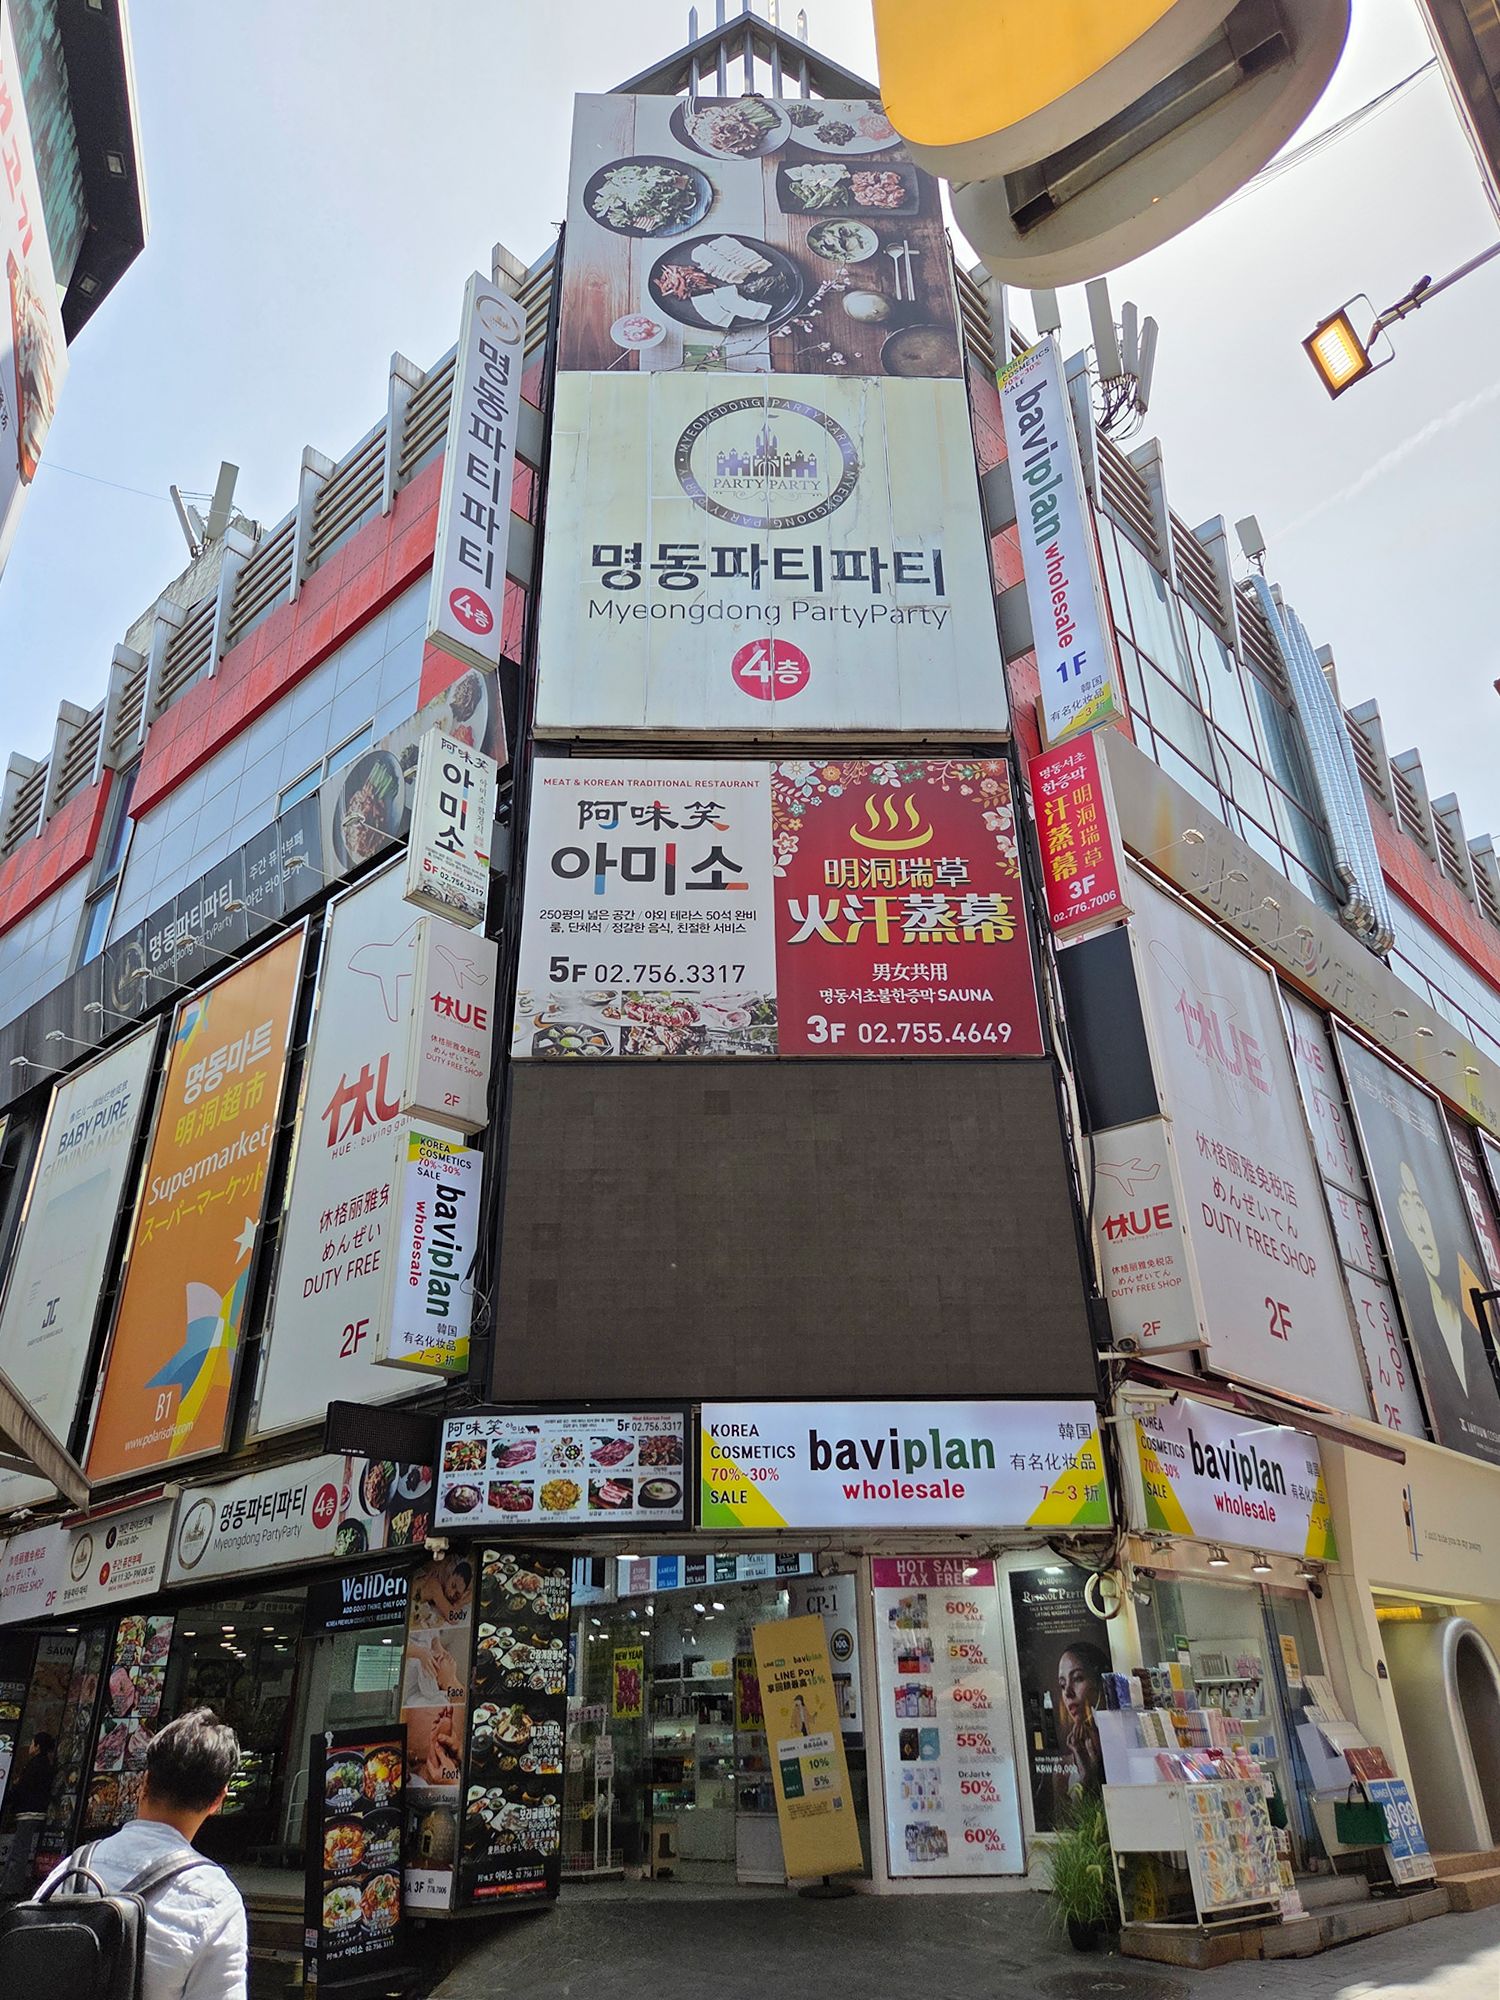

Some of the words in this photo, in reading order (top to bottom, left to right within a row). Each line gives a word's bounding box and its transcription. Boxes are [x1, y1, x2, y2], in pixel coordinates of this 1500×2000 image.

[1002, 346, 1050, 383] COSMETICS
[458, 336, 511, 590] 명동파티파티
[1014, 378, 1064, 546] baviplan
[713, 478, 765, 489] PARTY
[769, 479, 822, 491] PARTY
[592, 541, 945, 597] 명동파티파티
[1044, 541, 1074, 648] wholesale
[453, 594, 490, 628] 4층
[589, 599, 781, 627] Myeongdong
[793, 600, 947, 631] PartyParty
[740, 649, 802, 686] 4층
[1056, 650, 1088, 684] 1F
[440, 737, 490, 775] 阿味笑
[1038, 751, 1087, 781] 명동서초
[543, 778, 571, 787] MEAT
[574, 779, 582, 787] &
[584, 779, 625, 787] KOREAN
[627, 779, 692, 788] TRADITIONAL
[694, 779, 761, 789] RESTAURANT
[1040, 765, 1088, 797] 한증막
[434, 762, 476, 860] 아미소
[577, 800, 731, 832] 阿味笑
[1043, 793, 1079, 883] 汗蒸幕
[1071, 782, 1104, 874] 明洞瑞草
[422, 857, 439, 876] 5F
[439, 870, 485, 898] 02.756.3317
[550, 841, 750, 896] 아미소
[823, 856, 972, 890] 明洞瑞草
[1068, 873, 1097, 900] 3F
[540, 909, 584, 921] 250평의
[587, 909, 611, 921] 넓은
[613, 909, 635, 921] 공간
[644, 909, 667, 921] 야외
[670, 909, 703, 921] 테라스
[706, 909, 732, 921] 50석
[735, 909, 757, 921] 완비
[786, 892, 1018, 945] 火汗蒸幕
[1052, 888, 1118, 924] 02.776.7006
[149, 878, 234, 962] 명동파티파티
[568, 922, 603, 934] 단체석
[612, 922, 646, 935] 정갈한
[676, 922, 711, 935] 친절한
[713, 923, 747, 935] 서비스
[549, 956, 588, 983] 5F
[593, 964, 746, 984] 02.756.3317
[871, 961, 949, 982] 男女共用
[818, 986, 937, 1005] 명동서초불한증막
[937, 988, 994, 1002] SAUNA
[806, 1014, 847, 1045] 3F
[858, 1022, 1013, 1044] 02.755.4649
[183, 1018, 273, 1105] 명동마트
[425, 1050, 447, 1068] DUTY
[446, 1056, 464, 1074] FREE
[463, 1061, 484, 1080] SHOP
[174, 1071, 268, 1148] 明洞超市
[443, 1091, 461, 1109] 2F
[57, 1117, 94, 1157] BABY
[92, 1093, 132, 1137] PURE
[331, 1142, 352, 1160] HUE
[419, 1136, 452, 1154] KOREA
[148, 1119, 271, 1207] Supermarket
[417, 1157, 462, 1177] 70%~30%
[418, 1147, 473, 1170] COSMETICS
[416, 1166, 441, 1181] SALE
[139, 1166, 266, 1247] スーパーマーケット
[408, 1200, 427, 1287] wholesale
[425, 1182, 467, 1318] baviplan
[1200, 1201, 1243, 1243] DUTY
[1243, 1225, 1280, 1266] FREE
[1279, 1241, 1318, 1280] SHOP
[1327, 1101, 1358, 1185] DUTY
[1378, 1300, 1406, 1394] SHOP
[303, 1264, 343, 1299] DUTY
[346, 1250, 381, 1282] FREE
[1111, 1285, 1134, 1299] DUTY
[1135, 1282, 1156, 1296] FREE
[1157, 1277, 1183, 1292] SHOP
[1142, 1320, 1162, 1337] 2F
[1264, 1296, 1294, 1342] 2F
[339, 1317, 370, 1359] 2F
[154, 1391, 173, 1424] B1
[447, 1418, 504, 1438] 阿味笑
[617, 1419, 632, 1432] 5F
[631, 1421, 683, 1433] 02.756.3317
[710, 1423, 759, 1438] KOREA
[1057, 1422, 1092, 1440] 韓国
[710, 1444, 796, 1460] COSMETICS
[808, 1427, 996, 1474] baviplan
[1140, 1434, 1186, 1460] COSMETICS
[1009, 1452, 1097, 1472] 有名化妆品
[1187, 1427, 1287, 1496] baviplan
[710, 1467, 780, 1482] 70%~30%
[710, 1490, 748, 1504] SALE
[841, 1479, 966, 1500] wholesale
[1039, 1485, 1078, 1501] 7~3
[1083, 1484, 1099, 1502] 折
[1145, 1482, 1168, 1499] SALE
[219, 1484, 308, 1532] 명동파티파티
[313, 1491, 335, 1518] 4층
[1213, 1491, 1277, 1522] wholesale
[213, 1530, 262, 1552] Myeongdong
[262, 1523, 303, 1543] PartyParty
[658, 1566, 677, 1574] LANEIGE
[786, 1563, 799, 1573] SALE
[896, 1559, 926, 1574] HOT
[932, 1559, 971, 1573] SALE
[898, 1573, 929, 1587] TAX
[934, 1572, 972, 1587] FREE
[45, 1589, 58, 1608] 2F
[945, 1602, 979, 1615] 60%
[448, 1609, 468, 1622] Body
[949, 1644, 984, 1659] 55%
[774, 1670, 796, 1682] LINE
[798, 1668, 816, 1678] Pay
[447, 1686, 464, 1699] Face
[952, 1688, 988, 1703] 60%
[956, 1733, 992, 1748] 55%
[441, 1766, 460, 1780] Foot
[809, 1757, 830, 1770] 10%
[1035, 1763, 1053, 1774] KRW
[813, 1775, 830, 1787] 5%
[960, 1780, 996, 1795] 50%
[1398, 1801, 1418, 1826] 80
[964, 1828, 1001, 1844] 60%
[414, 1881, 425, 1894] 3F
